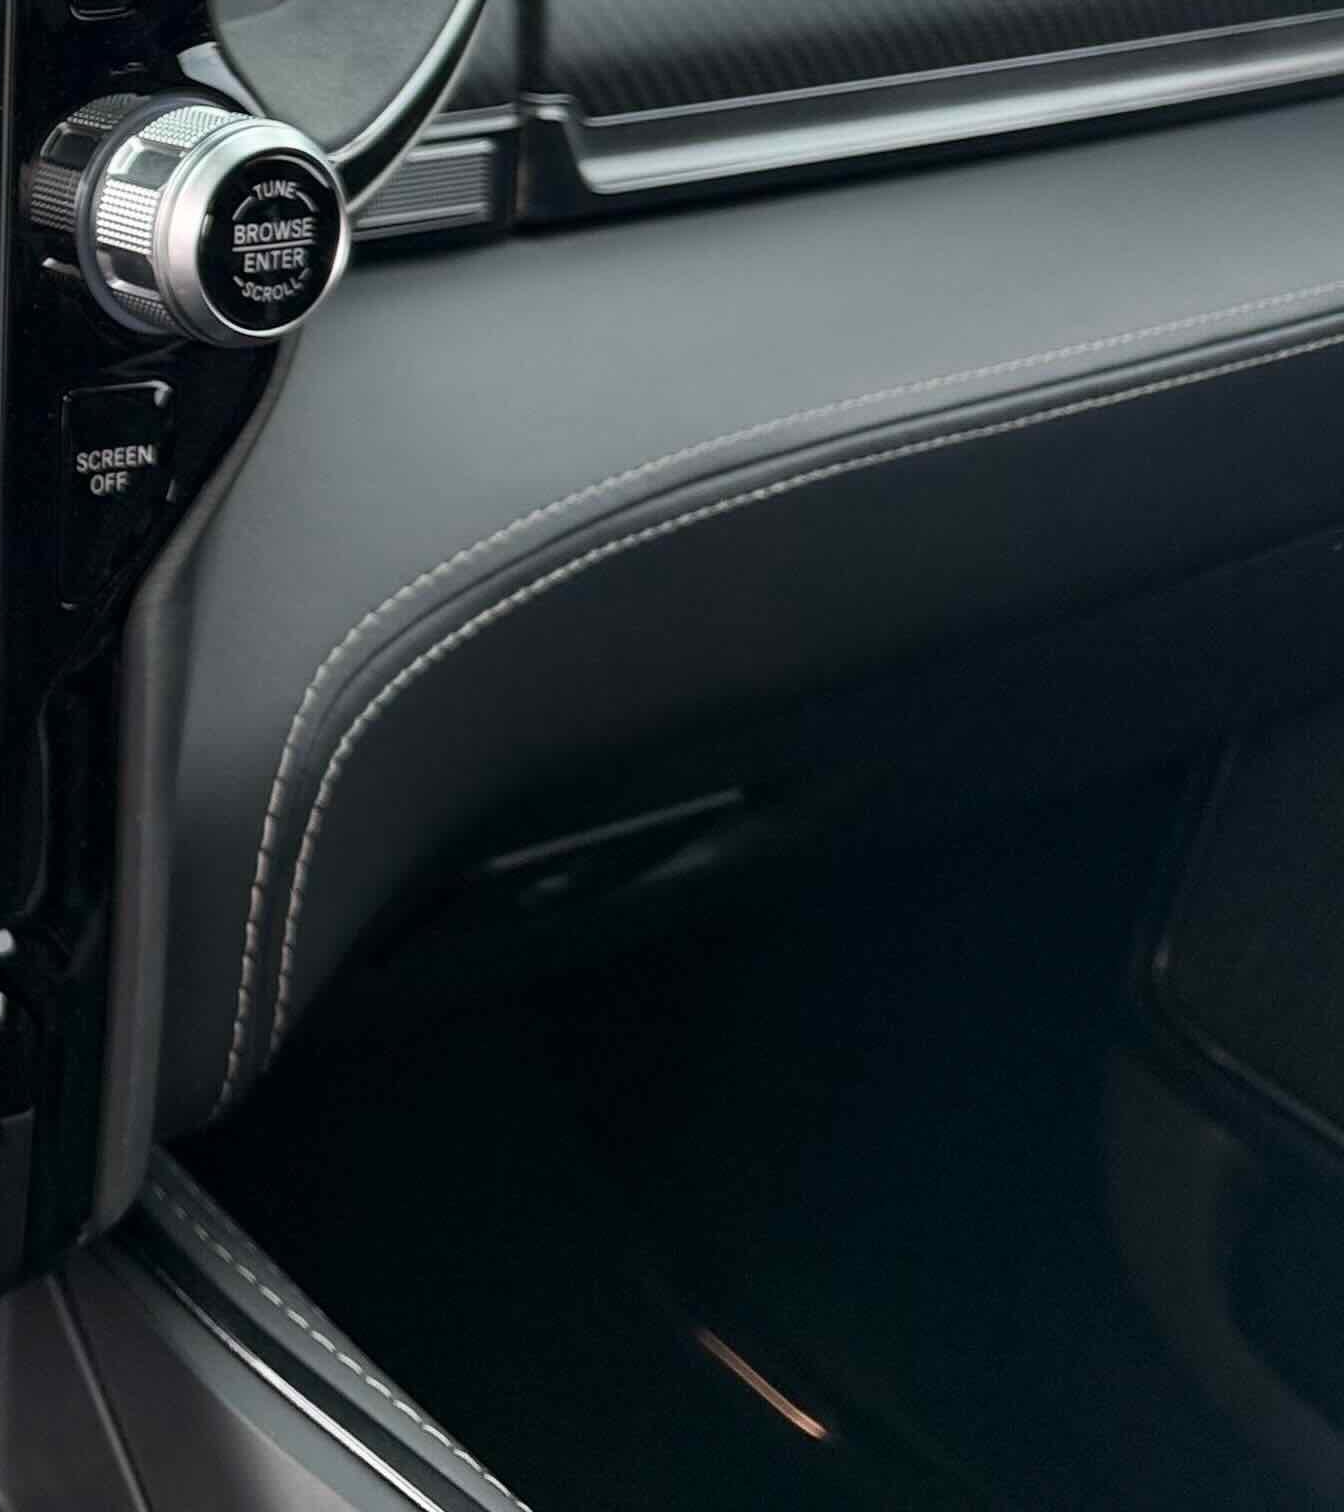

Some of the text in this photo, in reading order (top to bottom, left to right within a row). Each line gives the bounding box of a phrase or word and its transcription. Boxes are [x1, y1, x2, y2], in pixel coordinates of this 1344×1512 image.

[253, 180, 297, 200] TUNE
[233, 217, 313, 245] BROWSE
[244, 249, 305, 273] ENTER
[241, 277, 303, 303] SCROLL
[76, 444, 154, 472] SCREEN
[90, 471, 128, 496] OFF
